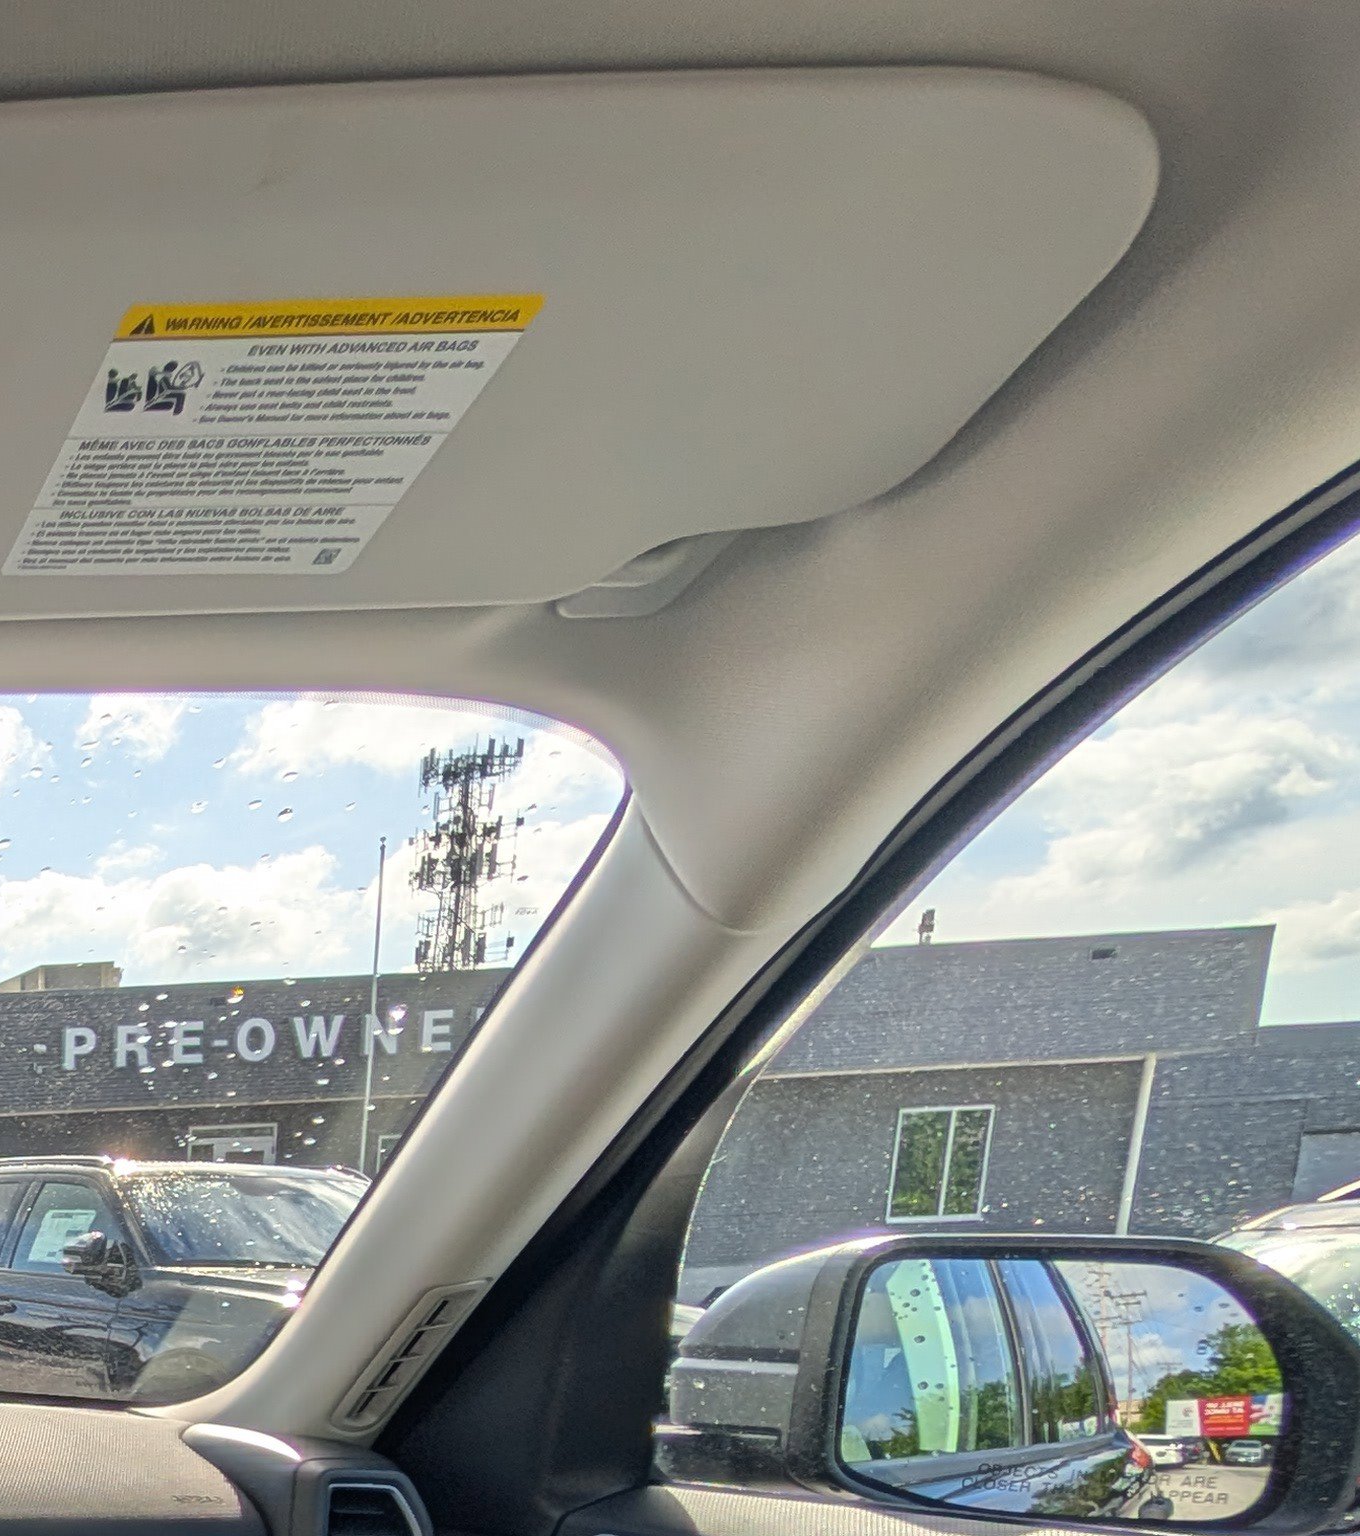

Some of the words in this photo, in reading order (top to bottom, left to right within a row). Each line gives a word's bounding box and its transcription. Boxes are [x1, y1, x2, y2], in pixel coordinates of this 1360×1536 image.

[165, 315, 243, 332] WARNING
[247, 344, 290, 357] EVEN
[289, 343, 328, 355] WITH
[327, 341, 409, 354] ADVANCED
[408, 341, 435, 353] AIR
[434, 340, 480, 352] BAGS
[120, 440, 158, 451] AVEC
[157, 439, 186, 450] DES
[187, 438, 226, 450] SACS
[226, 437, 317, 449] GONFLABLES
[317, 434, 432, 447] PERFECTIONNÉS
[58, 509, 127, 520] INCLUSIVE
[127, 508, 156, 519] CON
[156, 508, 184, 519] LAS
[185, 507, 237, 518] NUEVAS
[238, 507, 293, 517] BOLSAS
[292, 507, 312, 517] DE
[312, 507, 346, 517] AIRE
[962, 1477, 1031, 1492] CLOSER
[1180, 1475, 1219, 1489] ARE
